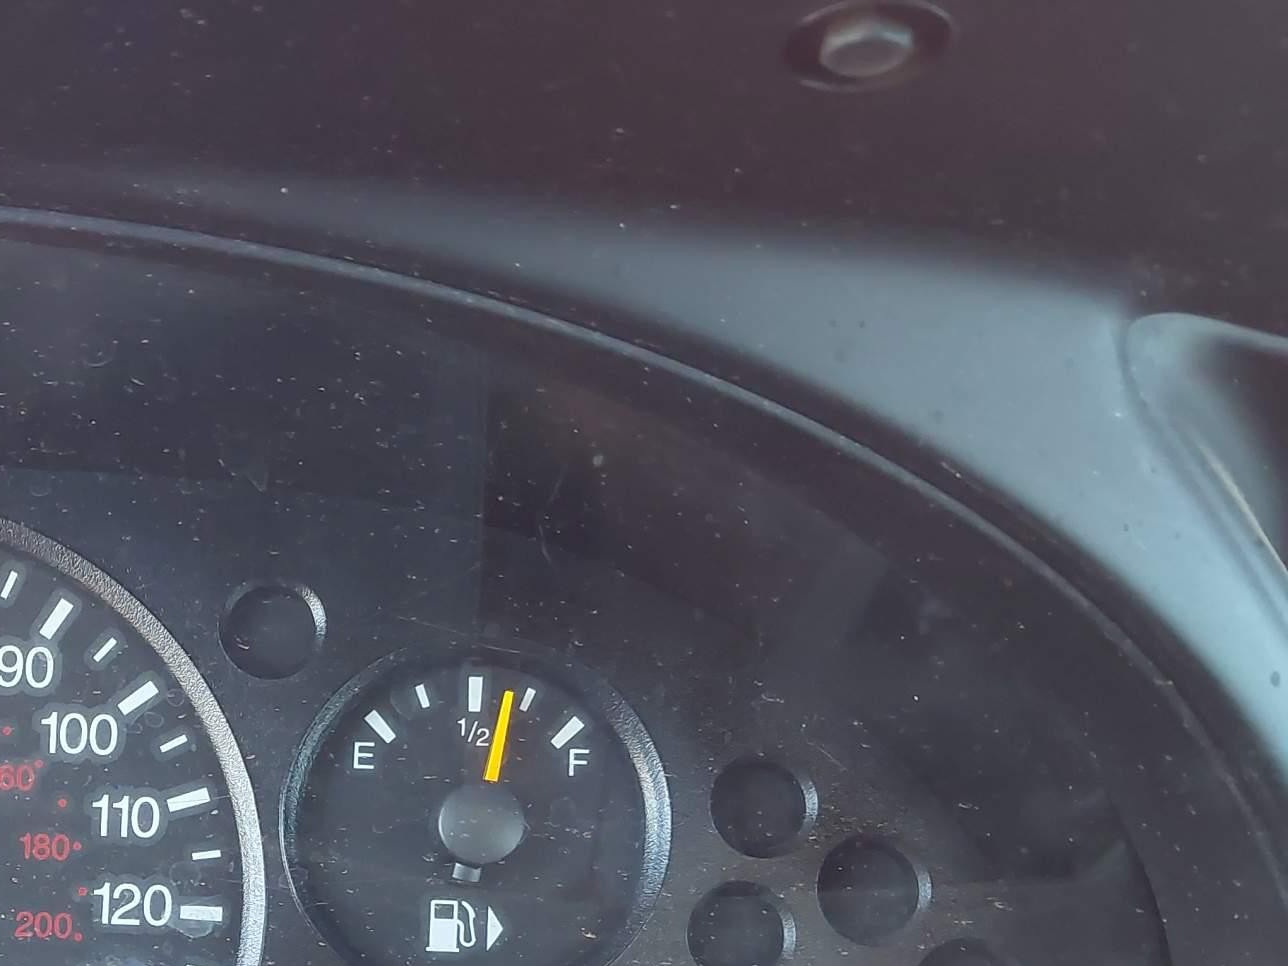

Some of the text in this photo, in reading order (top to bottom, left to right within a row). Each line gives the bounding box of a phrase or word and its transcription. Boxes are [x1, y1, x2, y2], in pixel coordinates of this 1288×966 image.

[41, 712, 118, 755] 100
[457, 717, 490, 746] 1/2
[353, 741, 375, 769] E
[568, 748, 590, 777] F
[92, 794, 160, 838] 110
[20, 832, 70, 860] 180
[93, 882, 172, 926] 120
[14, 912, 73, 938] 200
